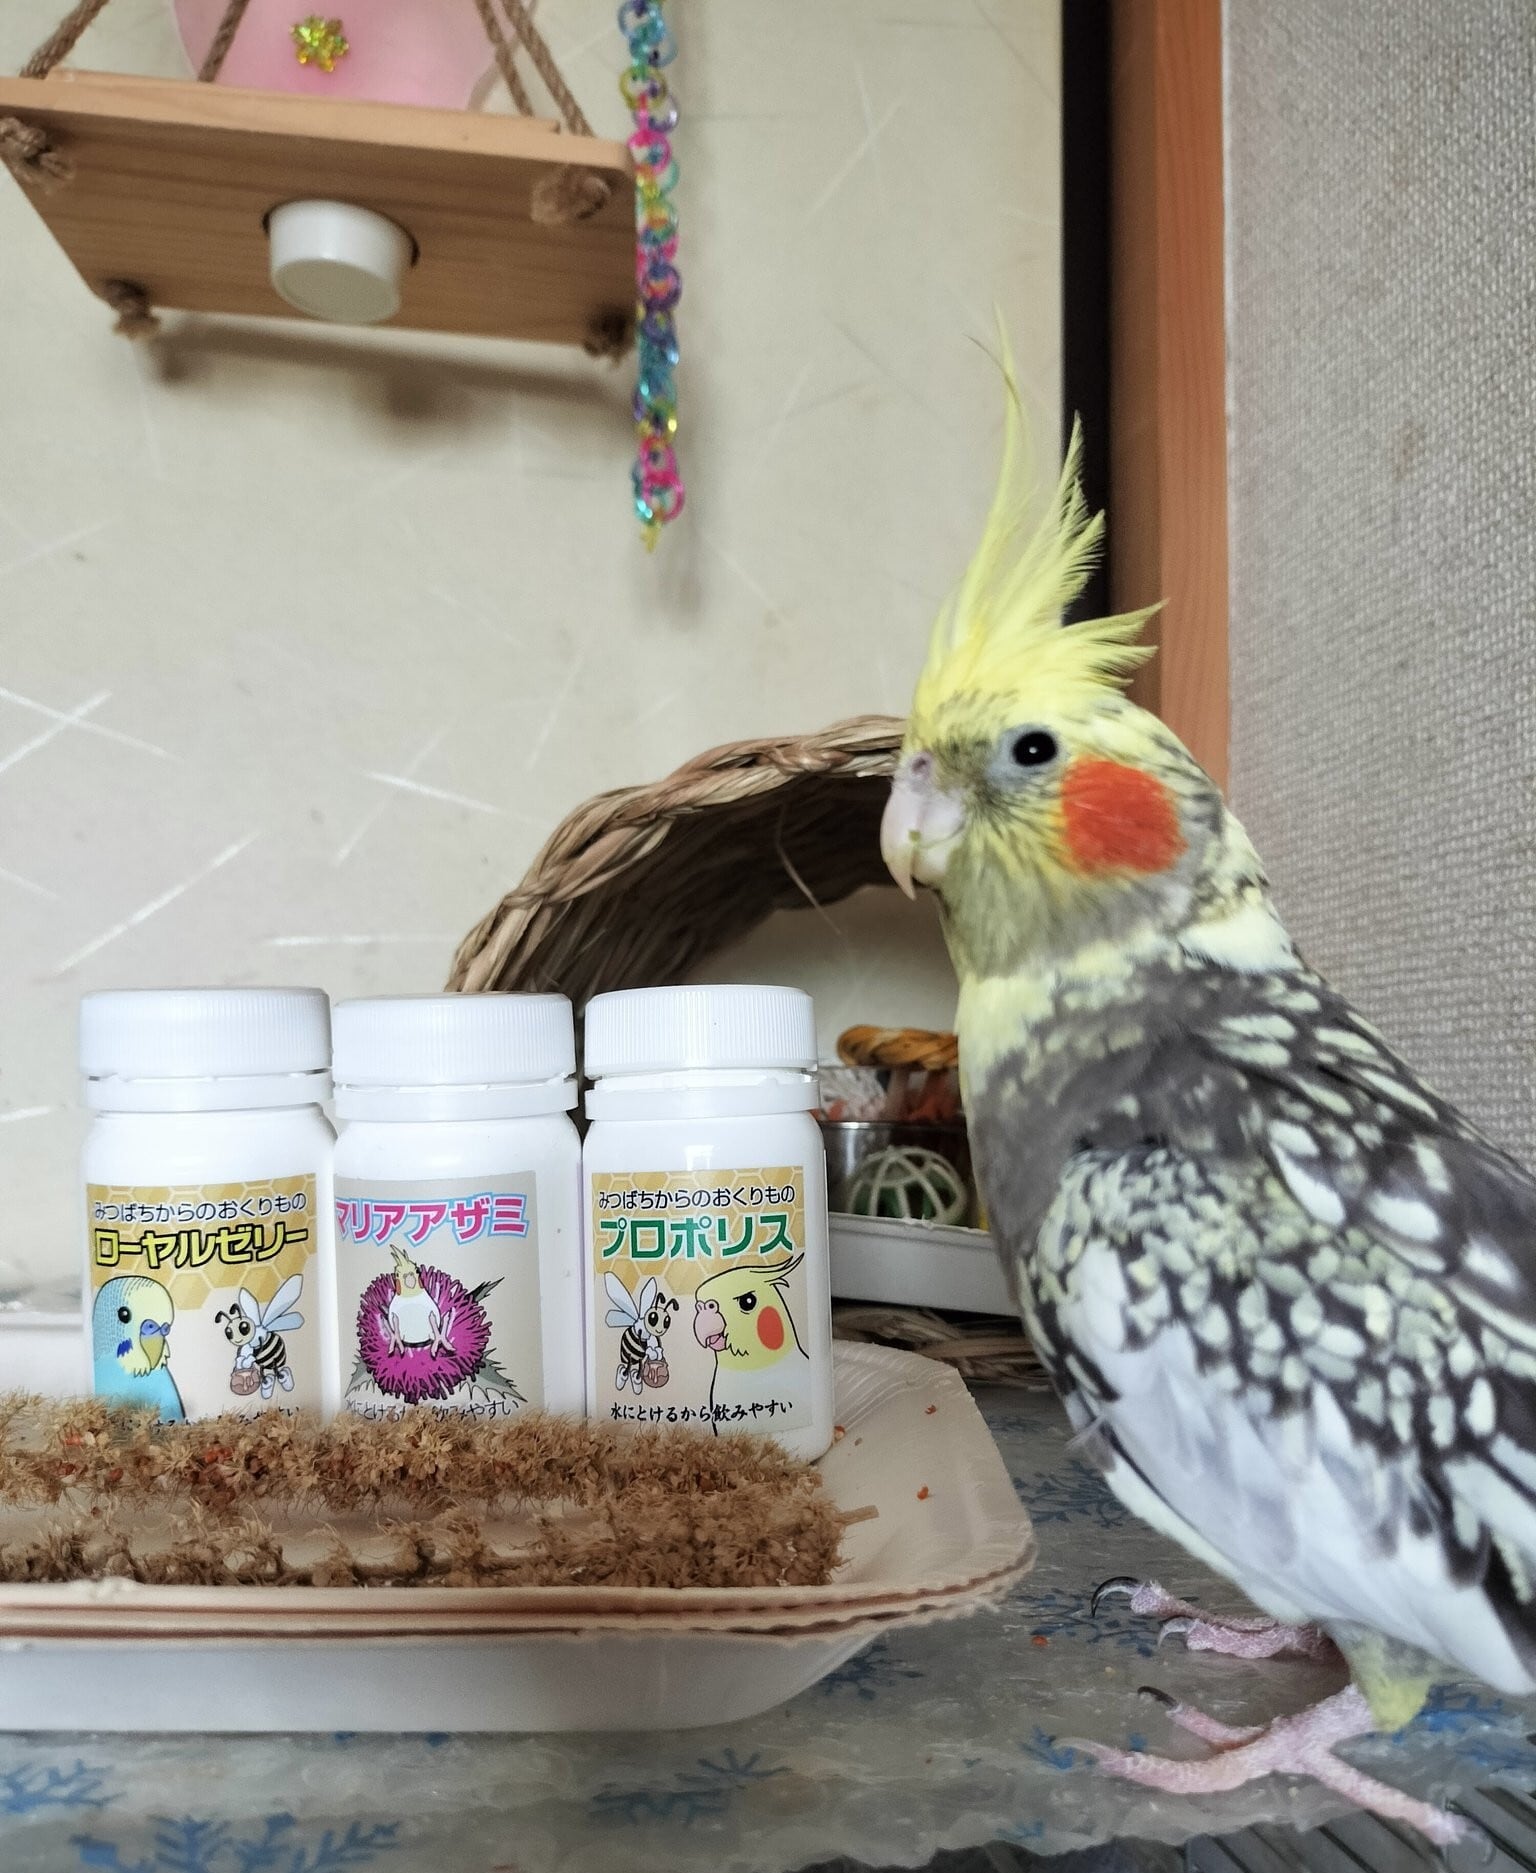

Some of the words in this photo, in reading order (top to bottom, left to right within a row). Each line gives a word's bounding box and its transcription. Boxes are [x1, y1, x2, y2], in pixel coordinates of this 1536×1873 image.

[95, 1193, 307, 1223] みつばちからのおくりもの
[599, 1185, 795, 1209] みつばちからのおくりもの
[336, 1193, 528, 1246] マリアアザミ
[600, 1214, 794, 1259] プロポリス
[94, 1222, 309, 1268] ローヤルゼリー
[610, 1399, 793, 1423] 水にとけるから飲みやすい
